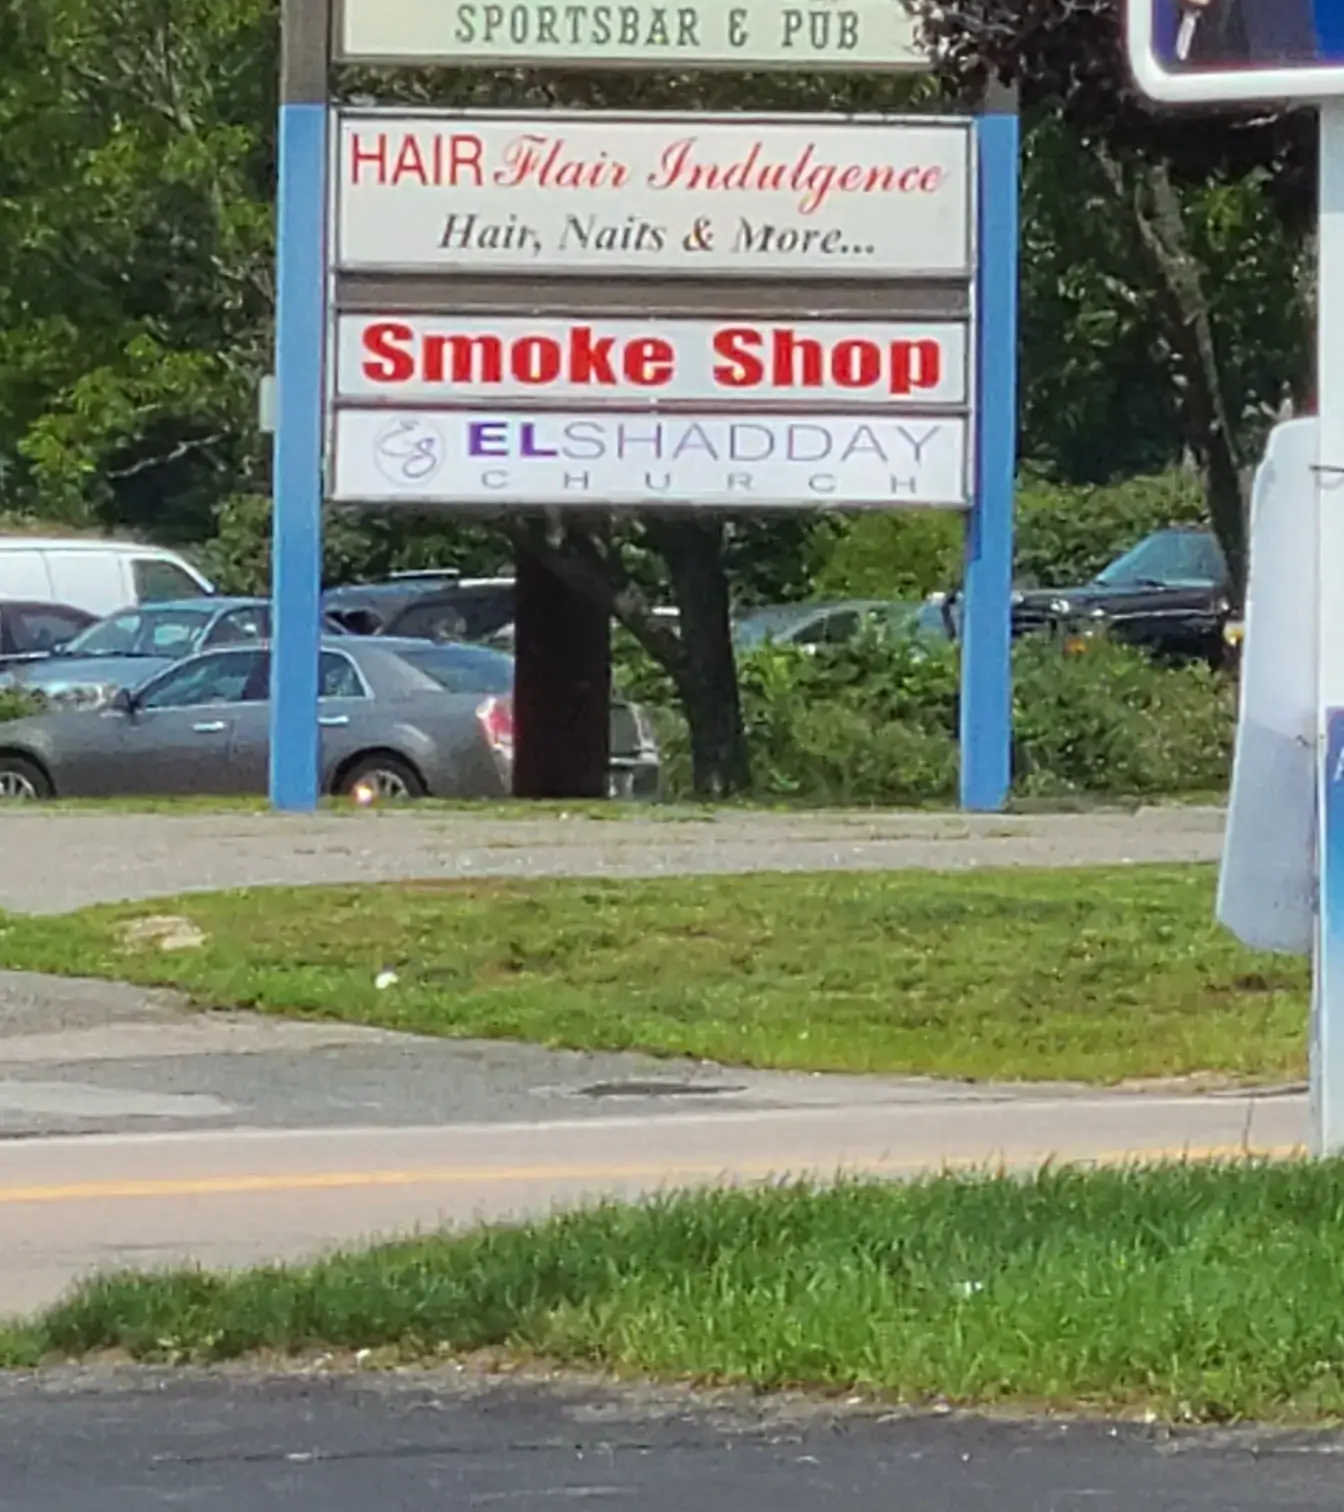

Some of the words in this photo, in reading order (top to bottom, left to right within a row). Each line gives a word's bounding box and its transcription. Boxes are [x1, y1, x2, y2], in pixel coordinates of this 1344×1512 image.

[455, 4, 701, 47] SPORTSBAR
[782, 9, 860, 51] PUB
[350, 133, 484, 187] HAIR
[494, 134, 632, 190] Flair
[647, 136, 946, 215] Indulgence
[437, 213, 543, 258] Hair,
[558, 215, 666, 253] Nails
[682, 216, 715, 254] &
[732, 218, 877, 256] More...
[360, 322, 676, 386] Smoke
[712, 328, 941, 394] Shop
[481, 472, 918, 495] CHURCH
